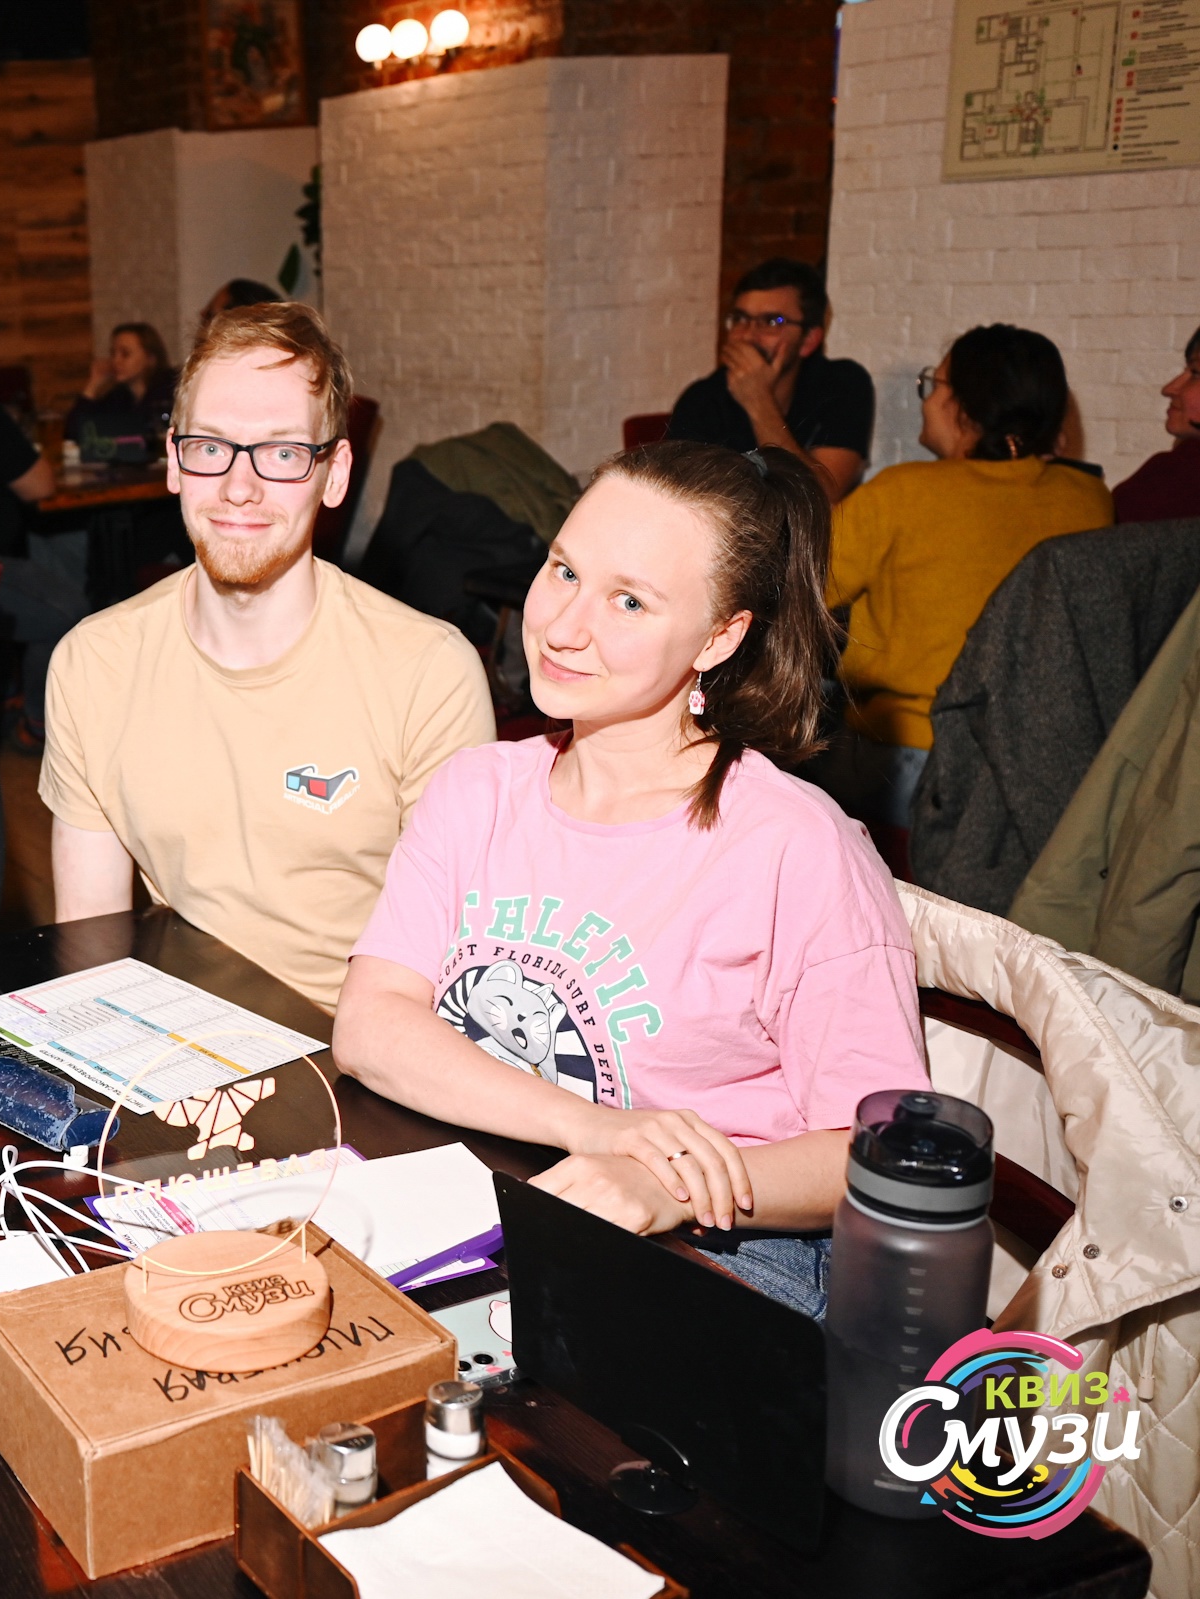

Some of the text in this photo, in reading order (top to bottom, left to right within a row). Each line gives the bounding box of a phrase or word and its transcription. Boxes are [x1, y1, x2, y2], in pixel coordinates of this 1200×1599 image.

[443, 890, 663, 1044] THLETIC
[492, 945, 567, 980] FLORIDA
[565, 978, 596, 1027] SURF
[114, 1148, 326, 1206] ПЛЮШЕВАЯ
[179, 1280, 315, 1323] Смузи
[222, 1274, 287, 1298] КВИЗ
